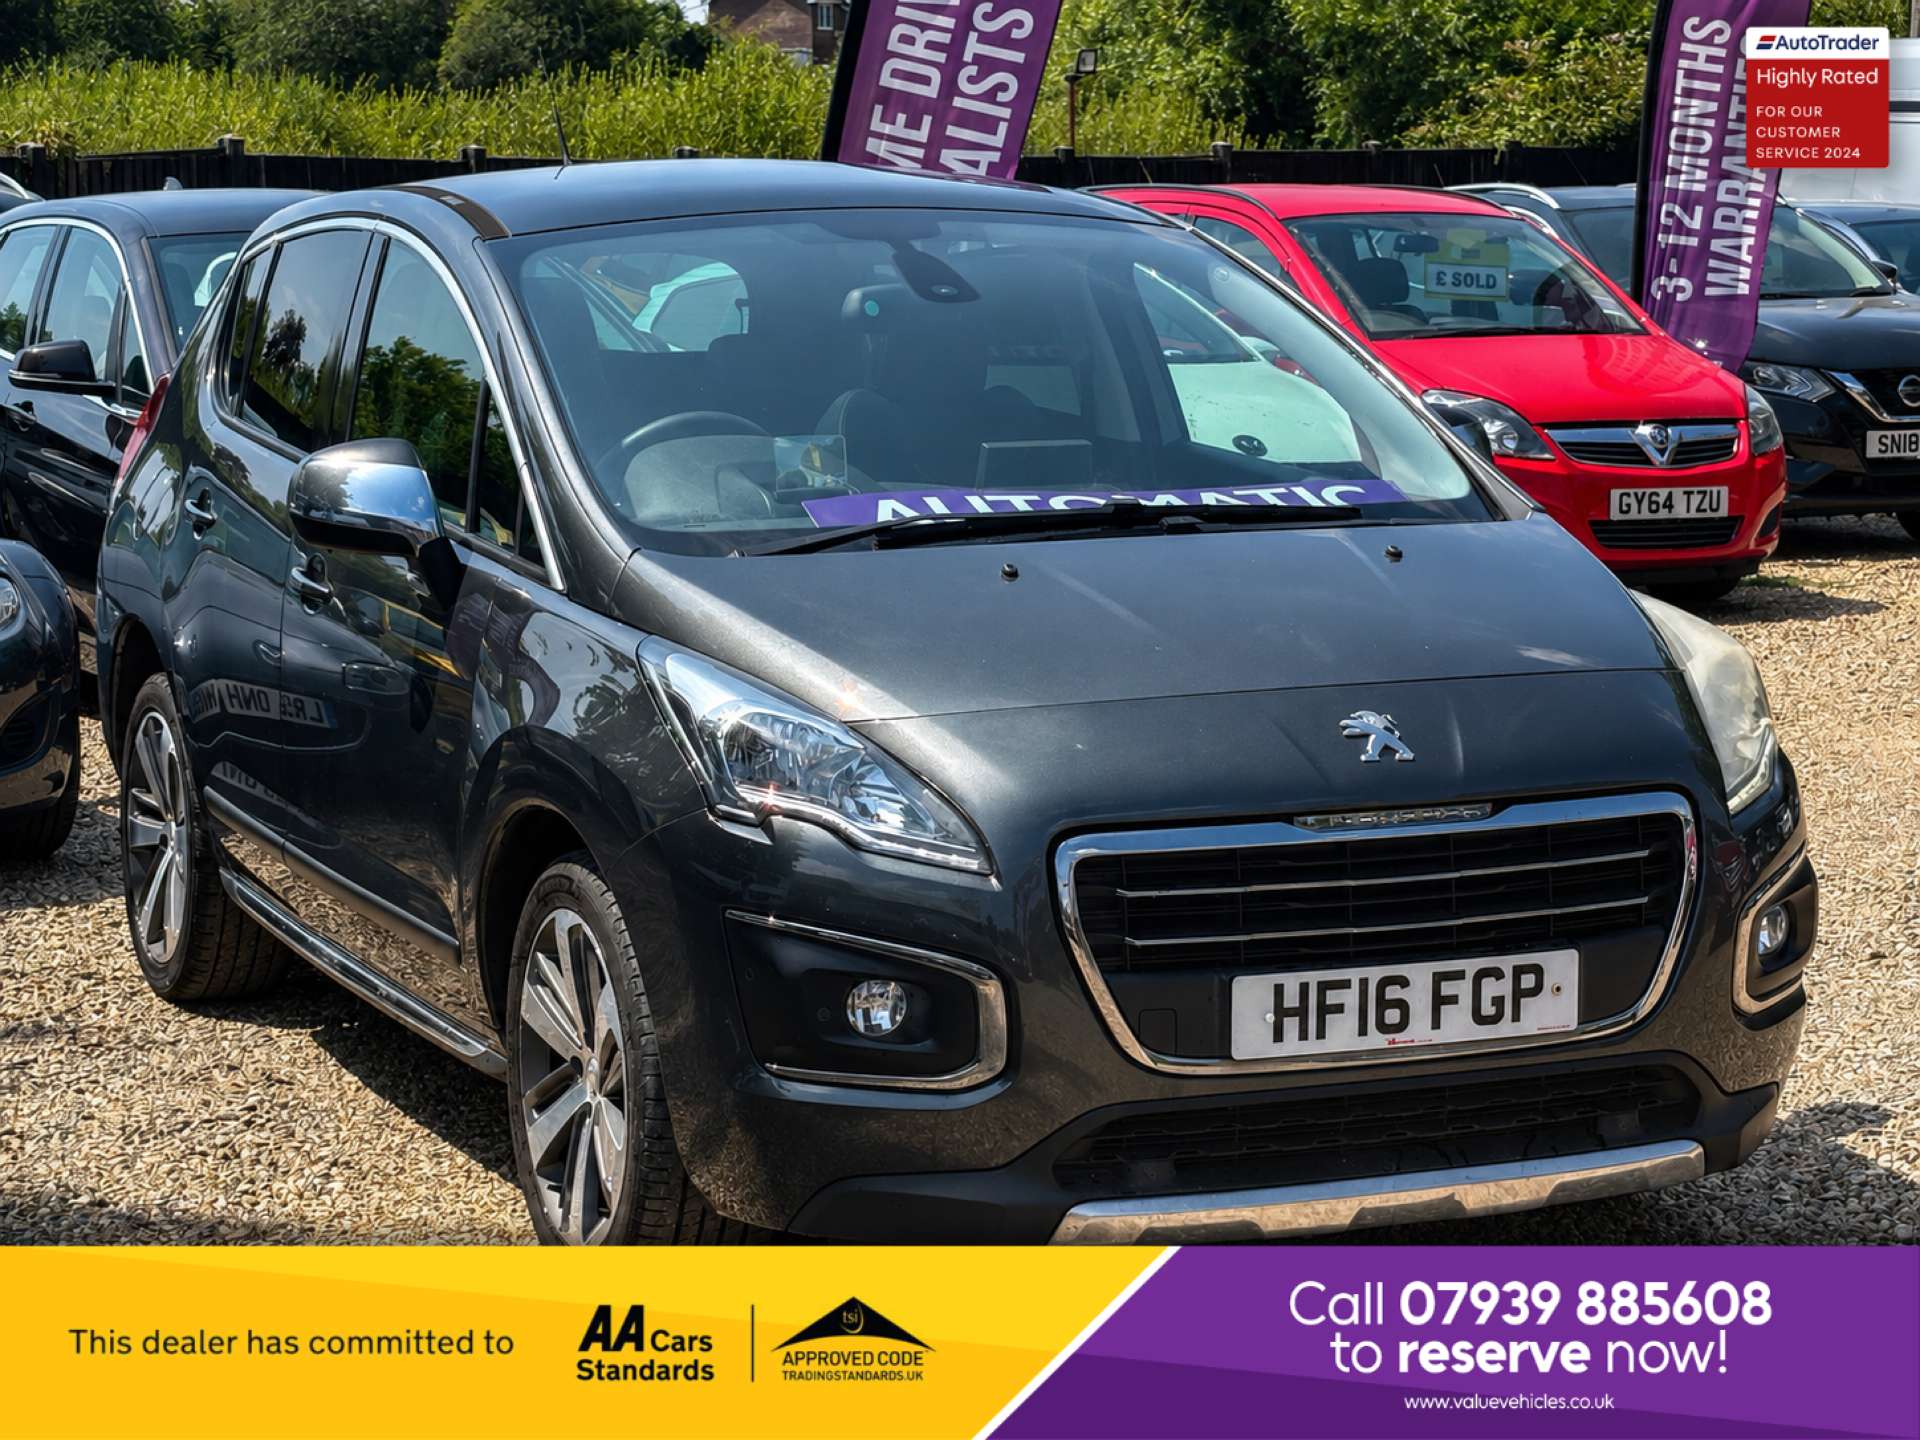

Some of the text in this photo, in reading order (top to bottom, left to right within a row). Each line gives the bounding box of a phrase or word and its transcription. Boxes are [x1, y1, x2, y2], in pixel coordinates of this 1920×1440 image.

[879, 0, 960, 99] DRI
[1664, 16, 1732, 193] MONTHS
[1704, 35, 1768, 297] WARRA
[1657, 203, 1704, 248] 12
[1451, 271, 1497, 290] SOLD
[1877, 433, 1920, 455] SN18
[1618, 488, 1721, 515] GY64 TZU
[1272, 963, 1544, 1043] HF16 FGP
